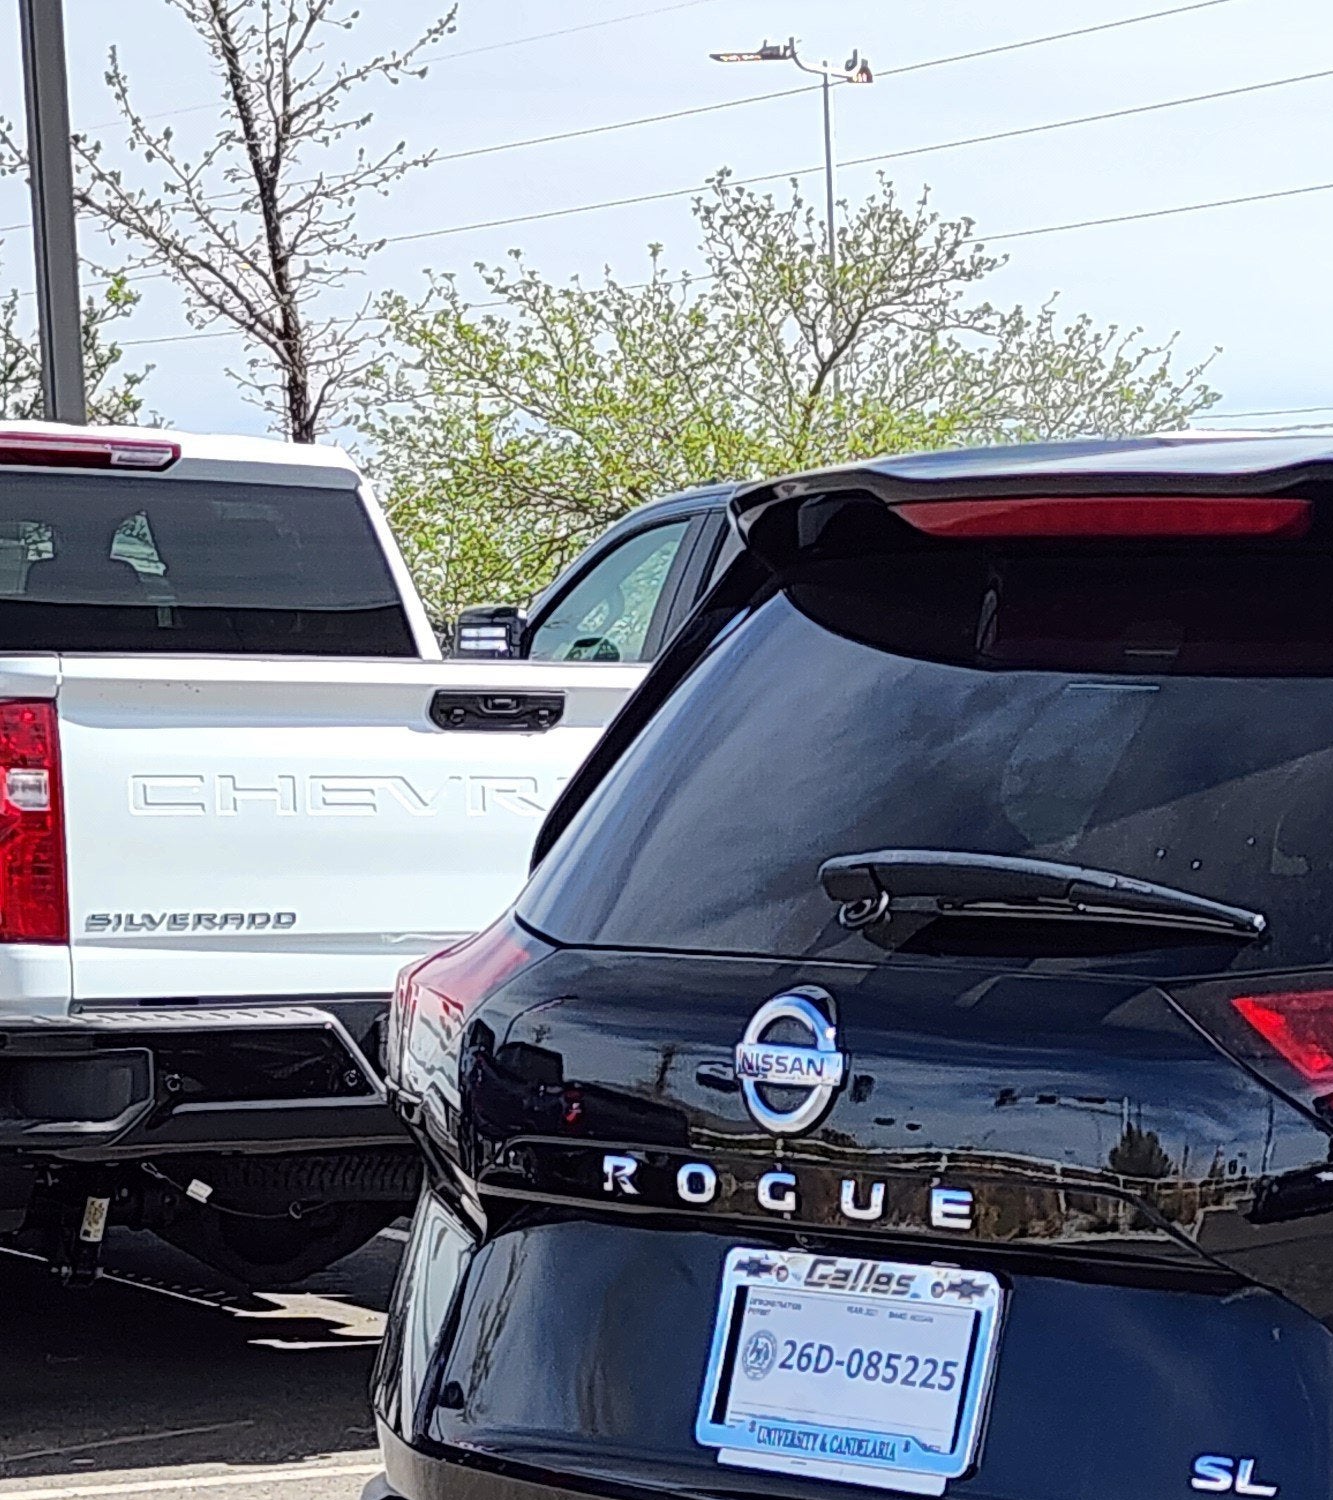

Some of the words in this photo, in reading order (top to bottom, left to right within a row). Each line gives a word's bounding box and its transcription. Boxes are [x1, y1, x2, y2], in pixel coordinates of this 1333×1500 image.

[128, 774, 568, 817] CHEVR
[85, 912, 297, 932] SILVERADO
[741, 1051, 827, 1079] NISSAN
[603, 1155, 974, 1230] ROGUE
[778, 1339, 959, 1392] 26D-085225
[757, 1425, 819, 1453] UNIVERSITY
[829, 1435, 896, 1461] CANDELARIA
[1191, 1455, 1278, 1498] SL
